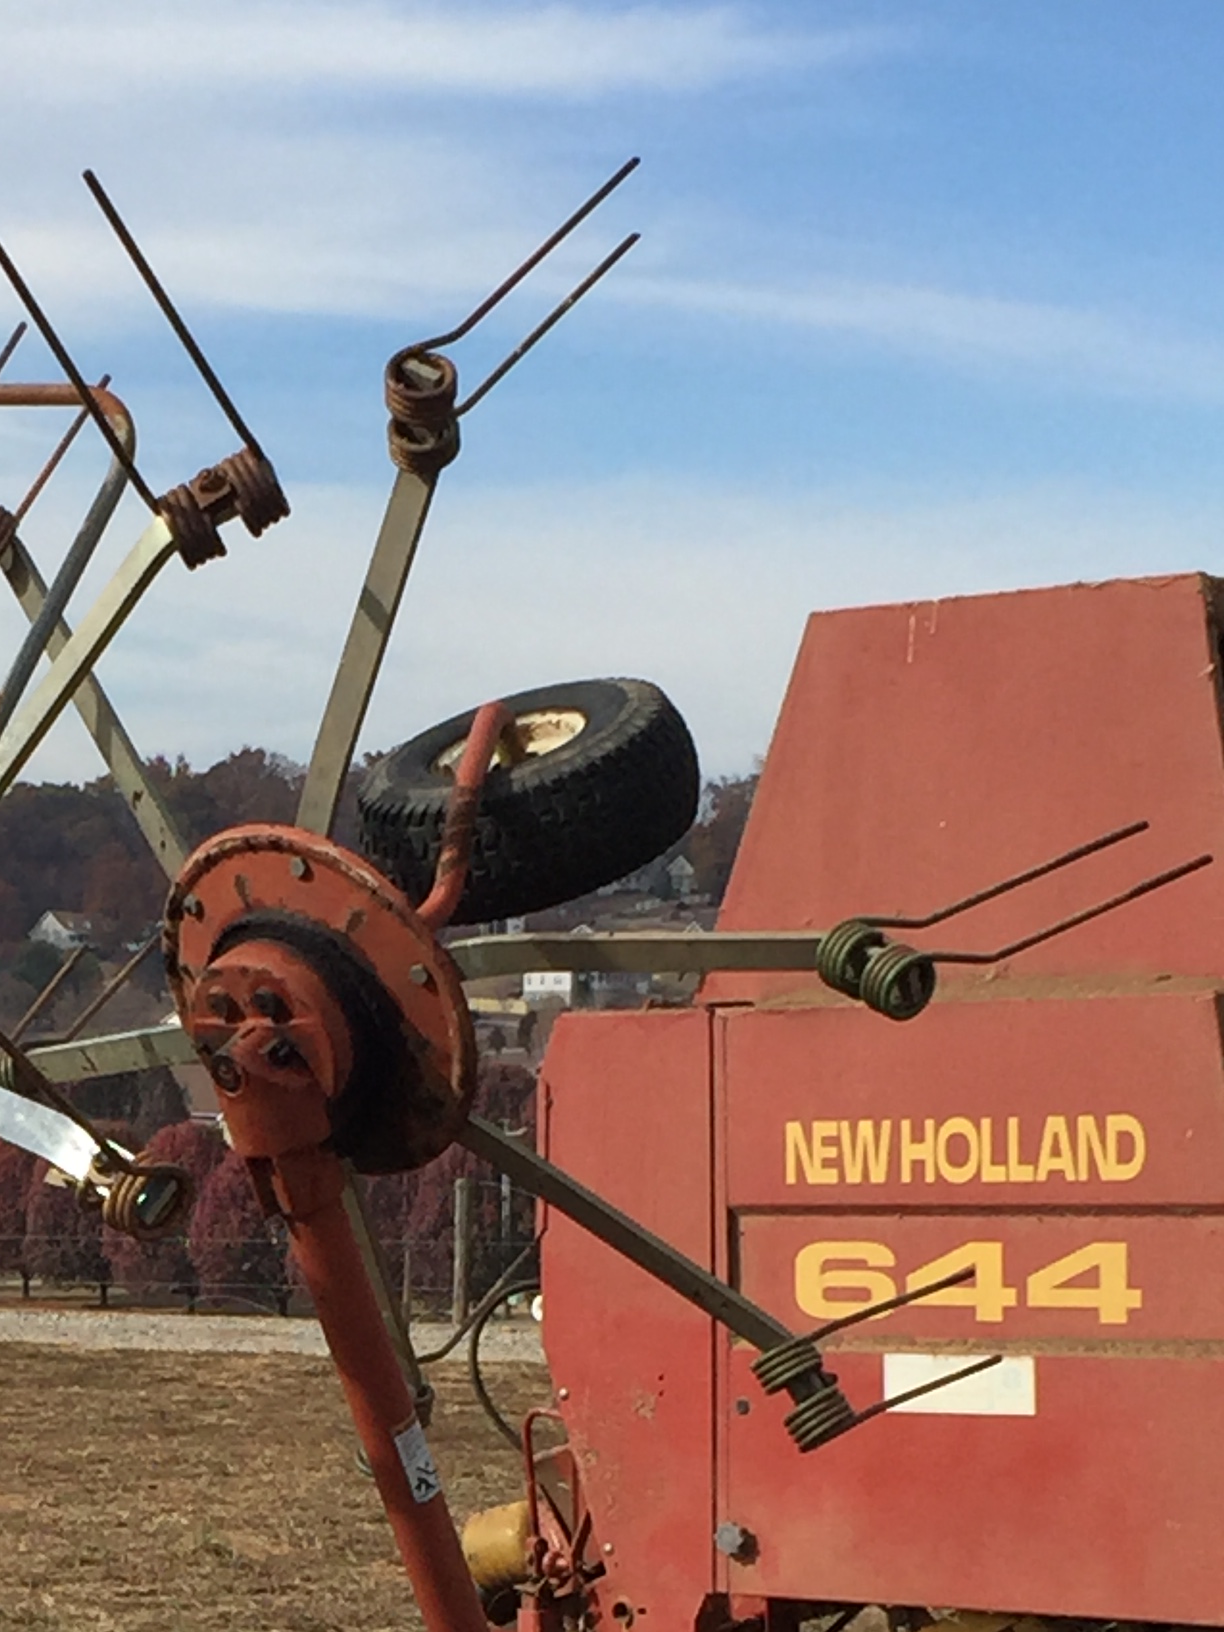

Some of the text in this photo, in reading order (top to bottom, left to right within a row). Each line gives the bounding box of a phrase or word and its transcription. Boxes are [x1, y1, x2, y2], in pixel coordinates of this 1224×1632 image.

[785, 1113, 1147, 1185] NEW HOLLAND
[794, 1240, 1143, 1325] 644
